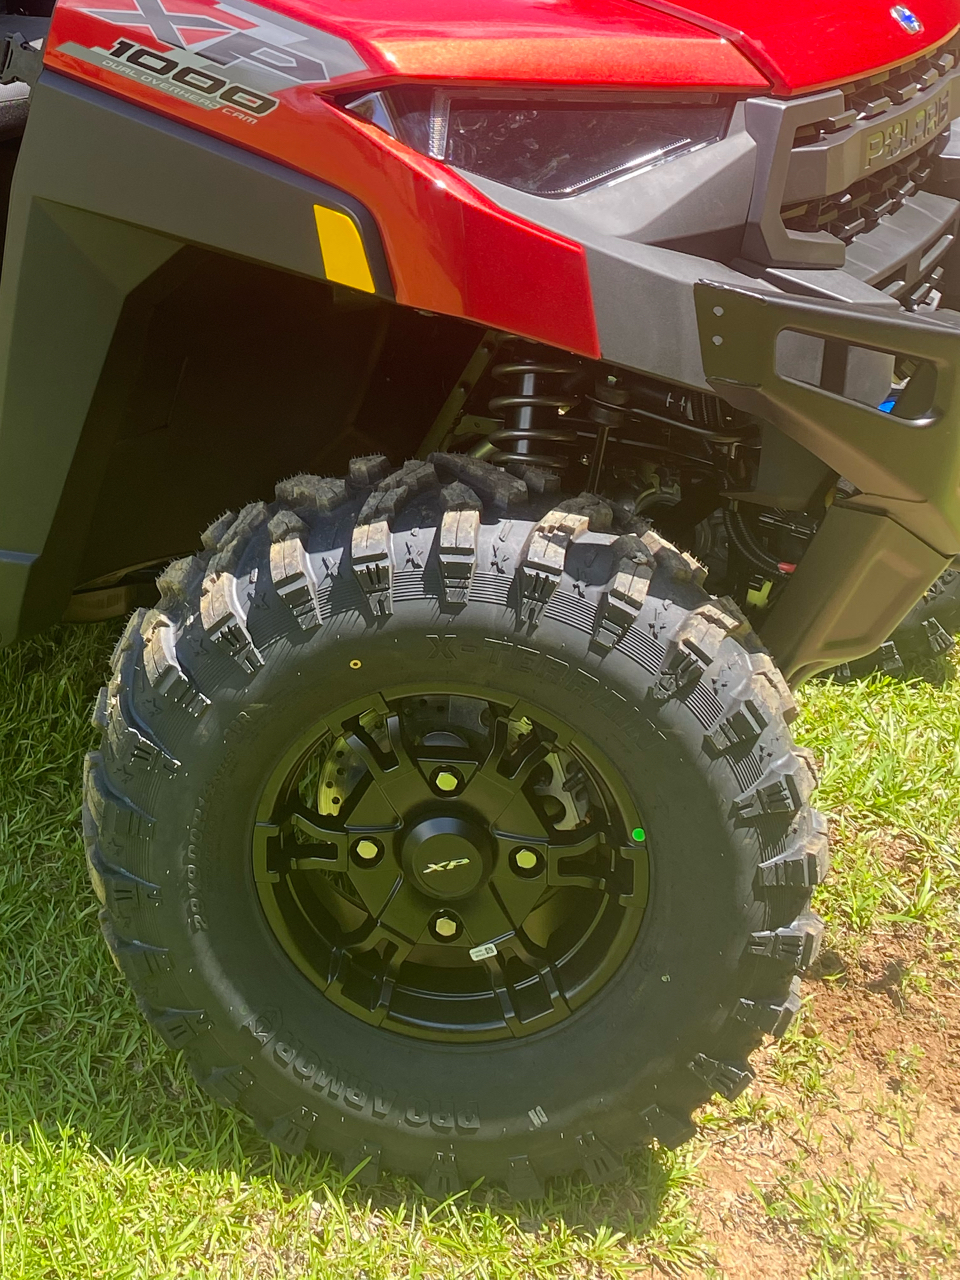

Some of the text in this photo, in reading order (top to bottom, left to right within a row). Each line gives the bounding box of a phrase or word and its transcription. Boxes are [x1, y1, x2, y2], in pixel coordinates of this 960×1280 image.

[102, 60, 258, 125] DUAL OVERHEAD CAM
[106, 37, 280, 119] 1000
[422, 858, 471, 874] XP
[272, 1031, 482, 1137] PRO ARMOR
